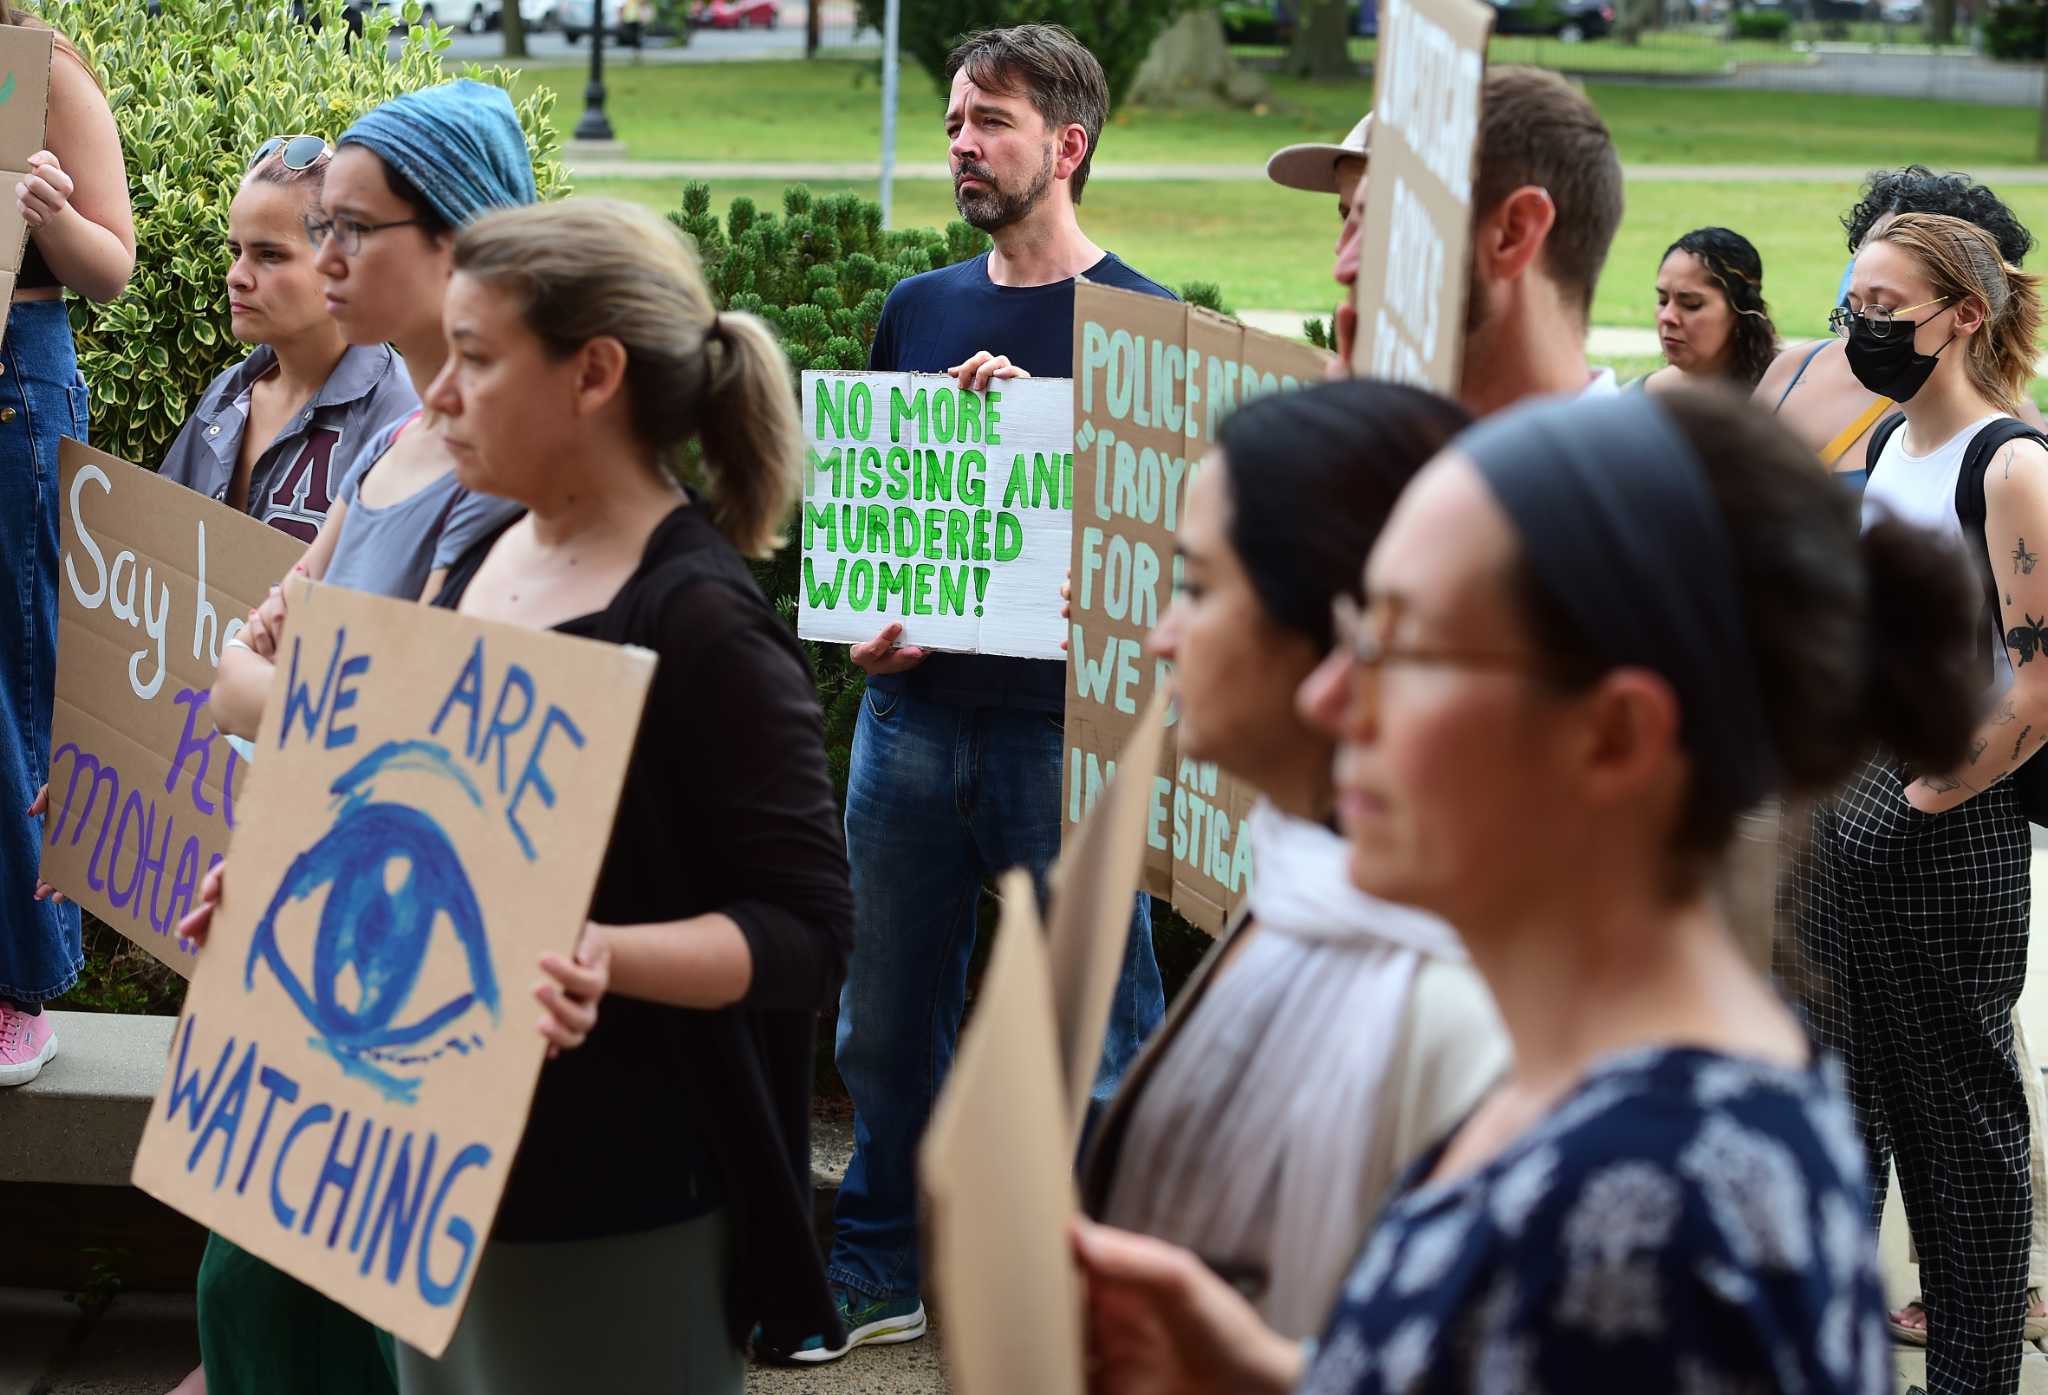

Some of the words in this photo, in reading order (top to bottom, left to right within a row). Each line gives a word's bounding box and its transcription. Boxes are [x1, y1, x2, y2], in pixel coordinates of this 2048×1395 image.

[815, 378, 873, 441] NO
[890, 386, 1002, 446] MORE
[1082, 320, 1201, 439] POLICE
[805, 446, 987, 507] MISSING
[65, 464, 170, 700] Say
[803, 501, 1023, 562] MURDERED
[1080, 526, 1161, 629] FOR
[803, 557, 991, 618] WOMEN!
[1072, 623, 1142, 714] WE
[278, 625, 372, 751] WE
[429, 636, 586, 863] ARE
[51, 741, 224, 956] MOHA
[165, 1012, 494, 1308] WATCHING
